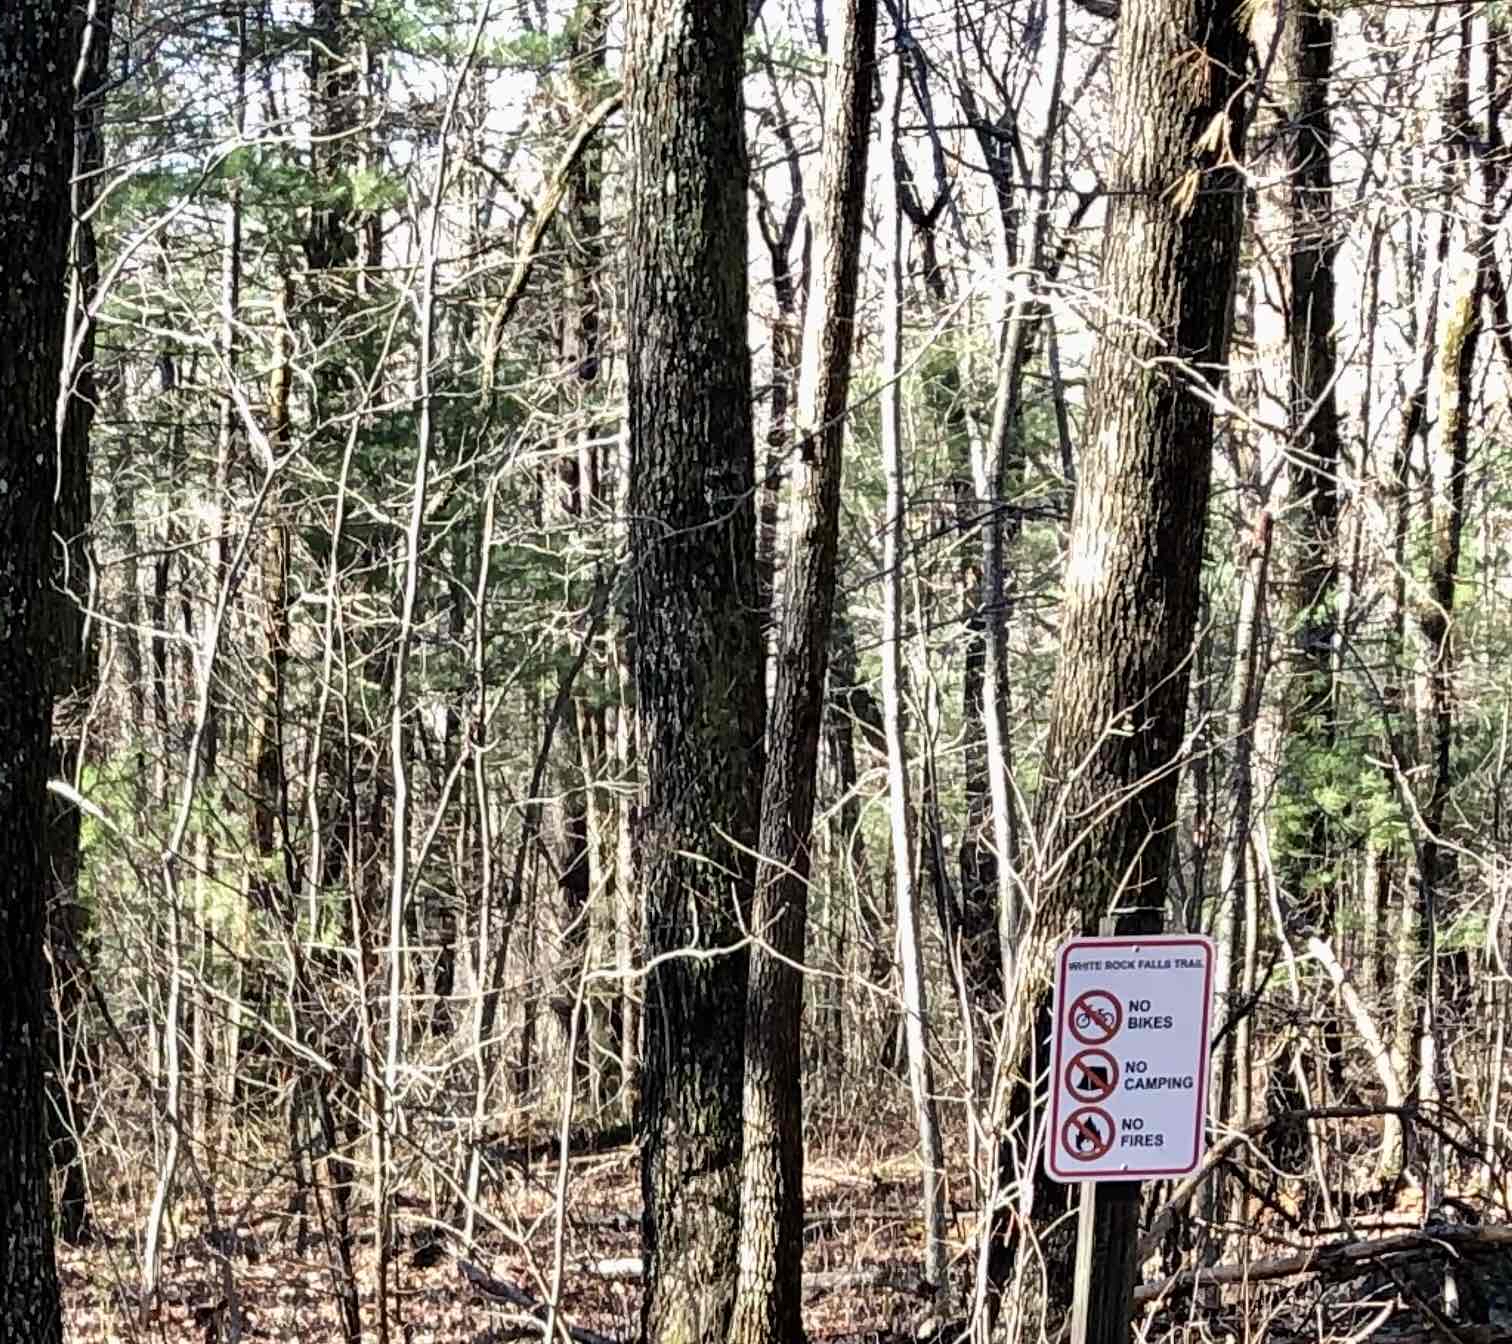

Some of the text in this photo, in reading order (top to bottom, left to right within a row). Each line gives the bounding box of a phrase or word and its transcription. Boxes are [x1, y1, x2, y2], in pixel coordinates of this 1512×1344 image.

[1069, 959, 1204, 970] WHITE ROCK FALLS TRAIL
[1129, 999, 1151, 1012] NO
[1128, 1016, 1173, 1029] BIKES
[1125, 1061, 1147, 1073] NO
[1124, 1076, 1194, 1090] CAMPING
[1122, 1118, 1143, 1130] NO
[1121, 1134, 1164, 1147] FIRES
